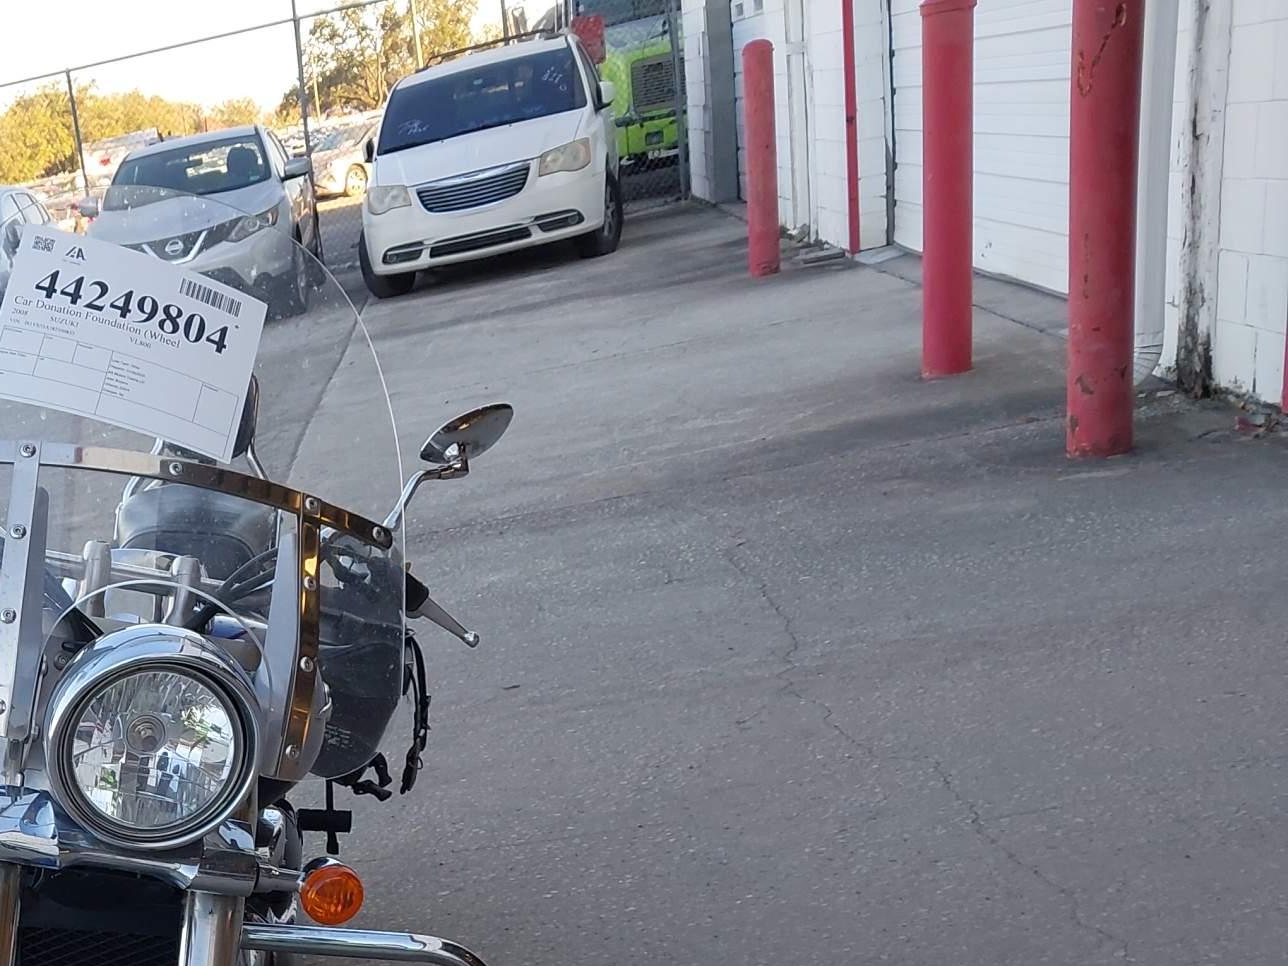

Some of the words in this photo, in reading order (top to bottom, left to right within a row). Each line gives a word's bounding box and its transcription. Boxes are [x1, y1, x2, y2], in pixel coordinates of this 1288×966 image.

[14, 295, 33, 306] Car
[36, 299, 82, 318] Donation
[85, 311, 141, 336] Foundation
[143, 329, 182, 349] (Wheel
[35, 269, 229, 355] 44249804
